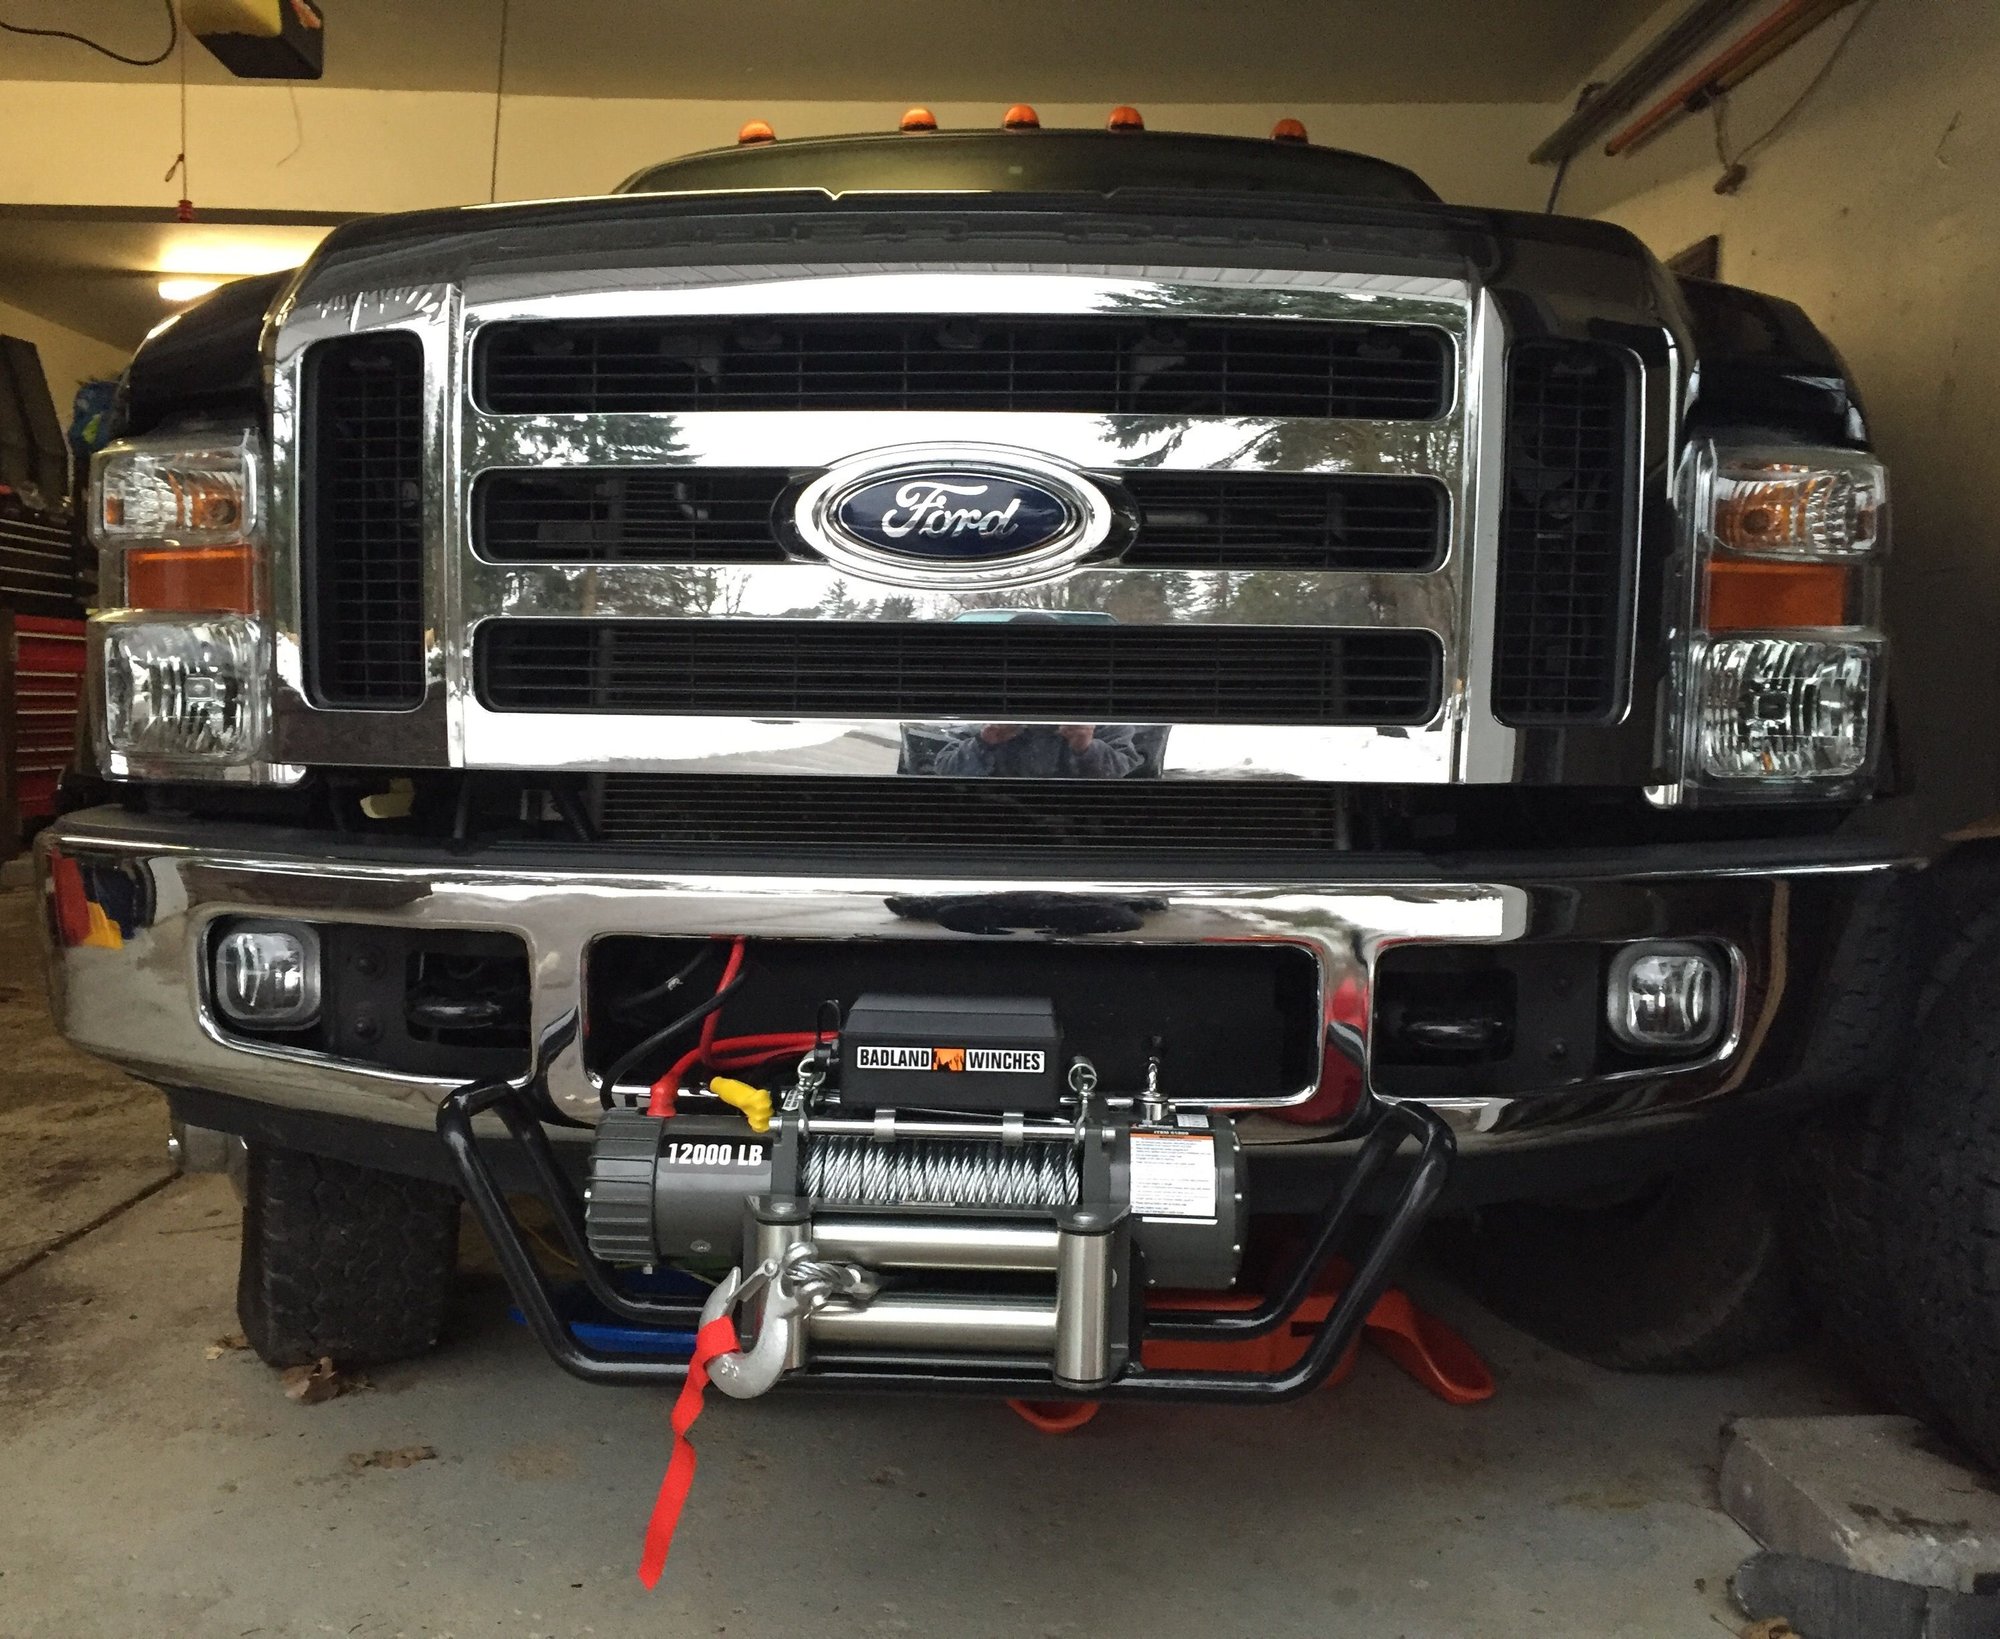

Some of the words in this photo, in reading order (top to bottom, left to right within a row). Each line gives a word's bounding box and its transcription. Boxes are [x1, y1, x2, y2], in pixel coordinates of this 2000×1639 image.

[881, 481, 1021, 538] Ford
[860, 1049, 930, 1067] BADLAND
[969, 1051, 1041, 1071] WINCHES
[668, 1143, 732, 1165] 12000
[737, 1144, 764, 1166] LB
